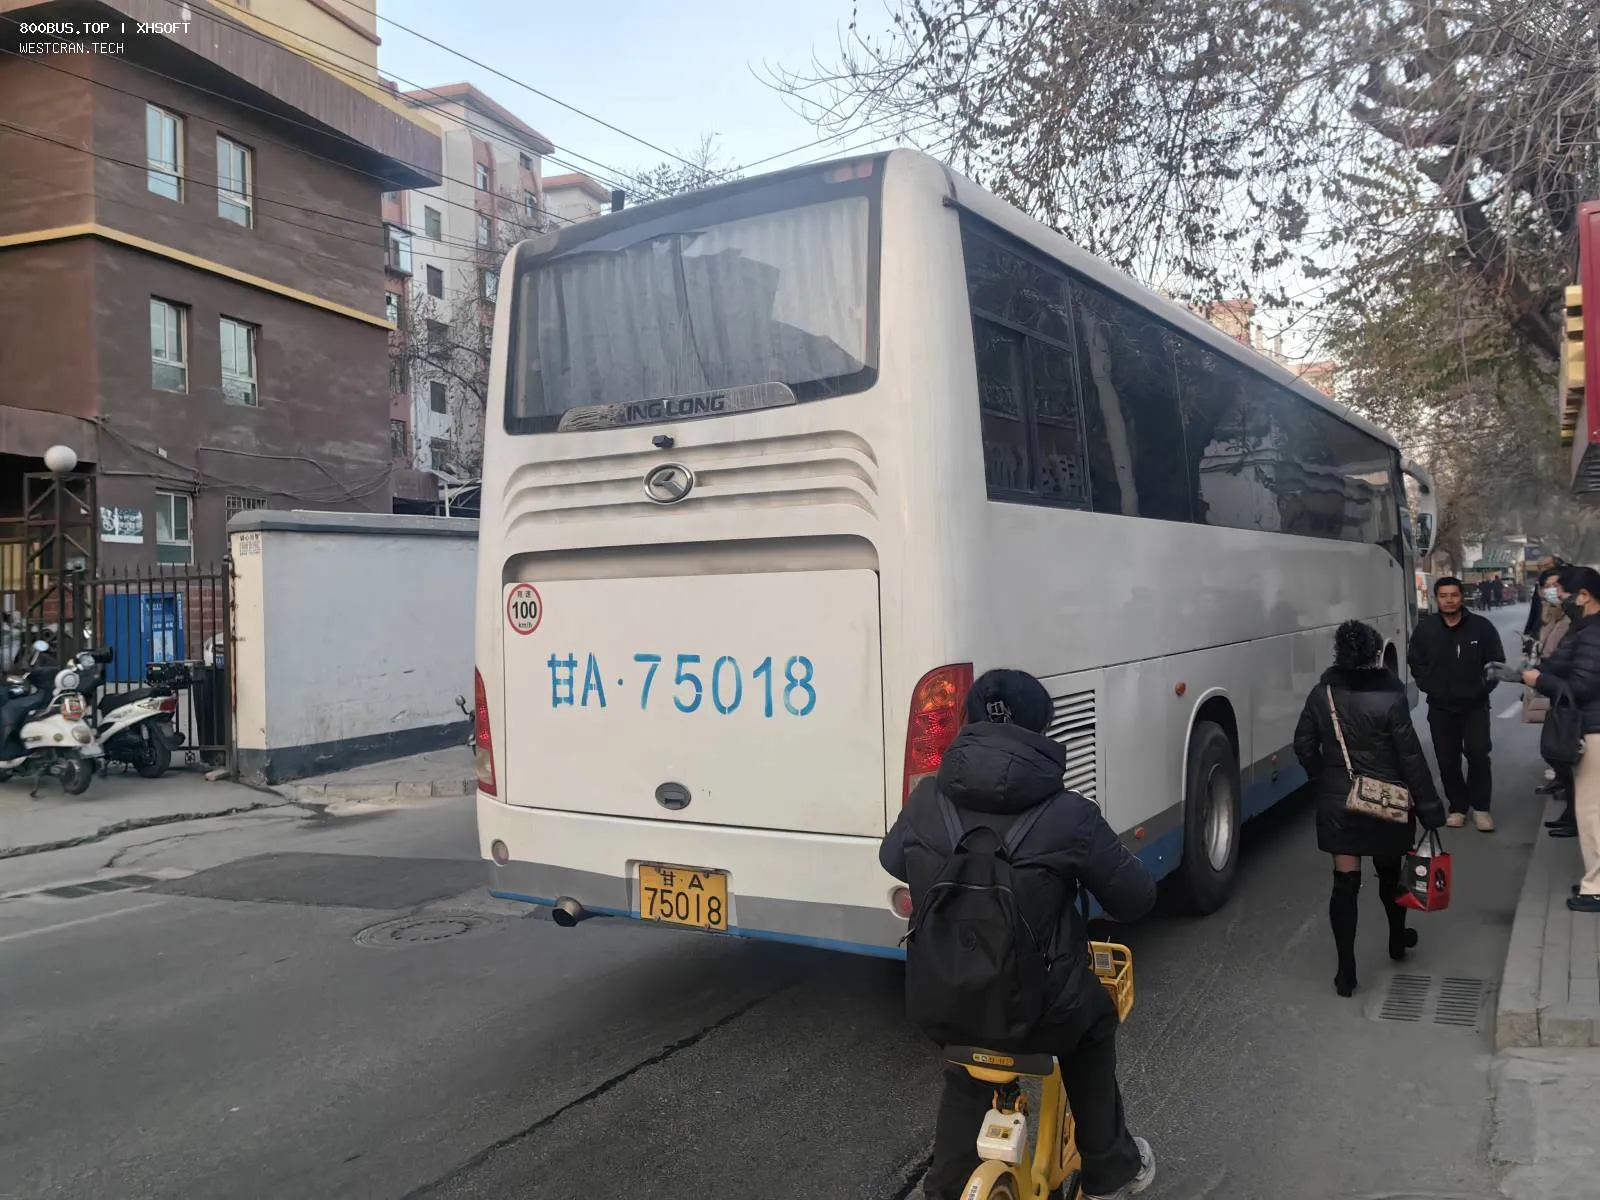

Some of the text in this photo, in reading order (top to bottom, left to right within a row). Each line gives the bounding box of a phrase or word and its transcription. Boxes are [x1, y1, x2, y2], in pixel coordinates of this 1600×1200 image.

[619, 395, 725, 422] ING LONG
[512, 601, 537, 619] 100
[644, 887, 722, 925] 75018
